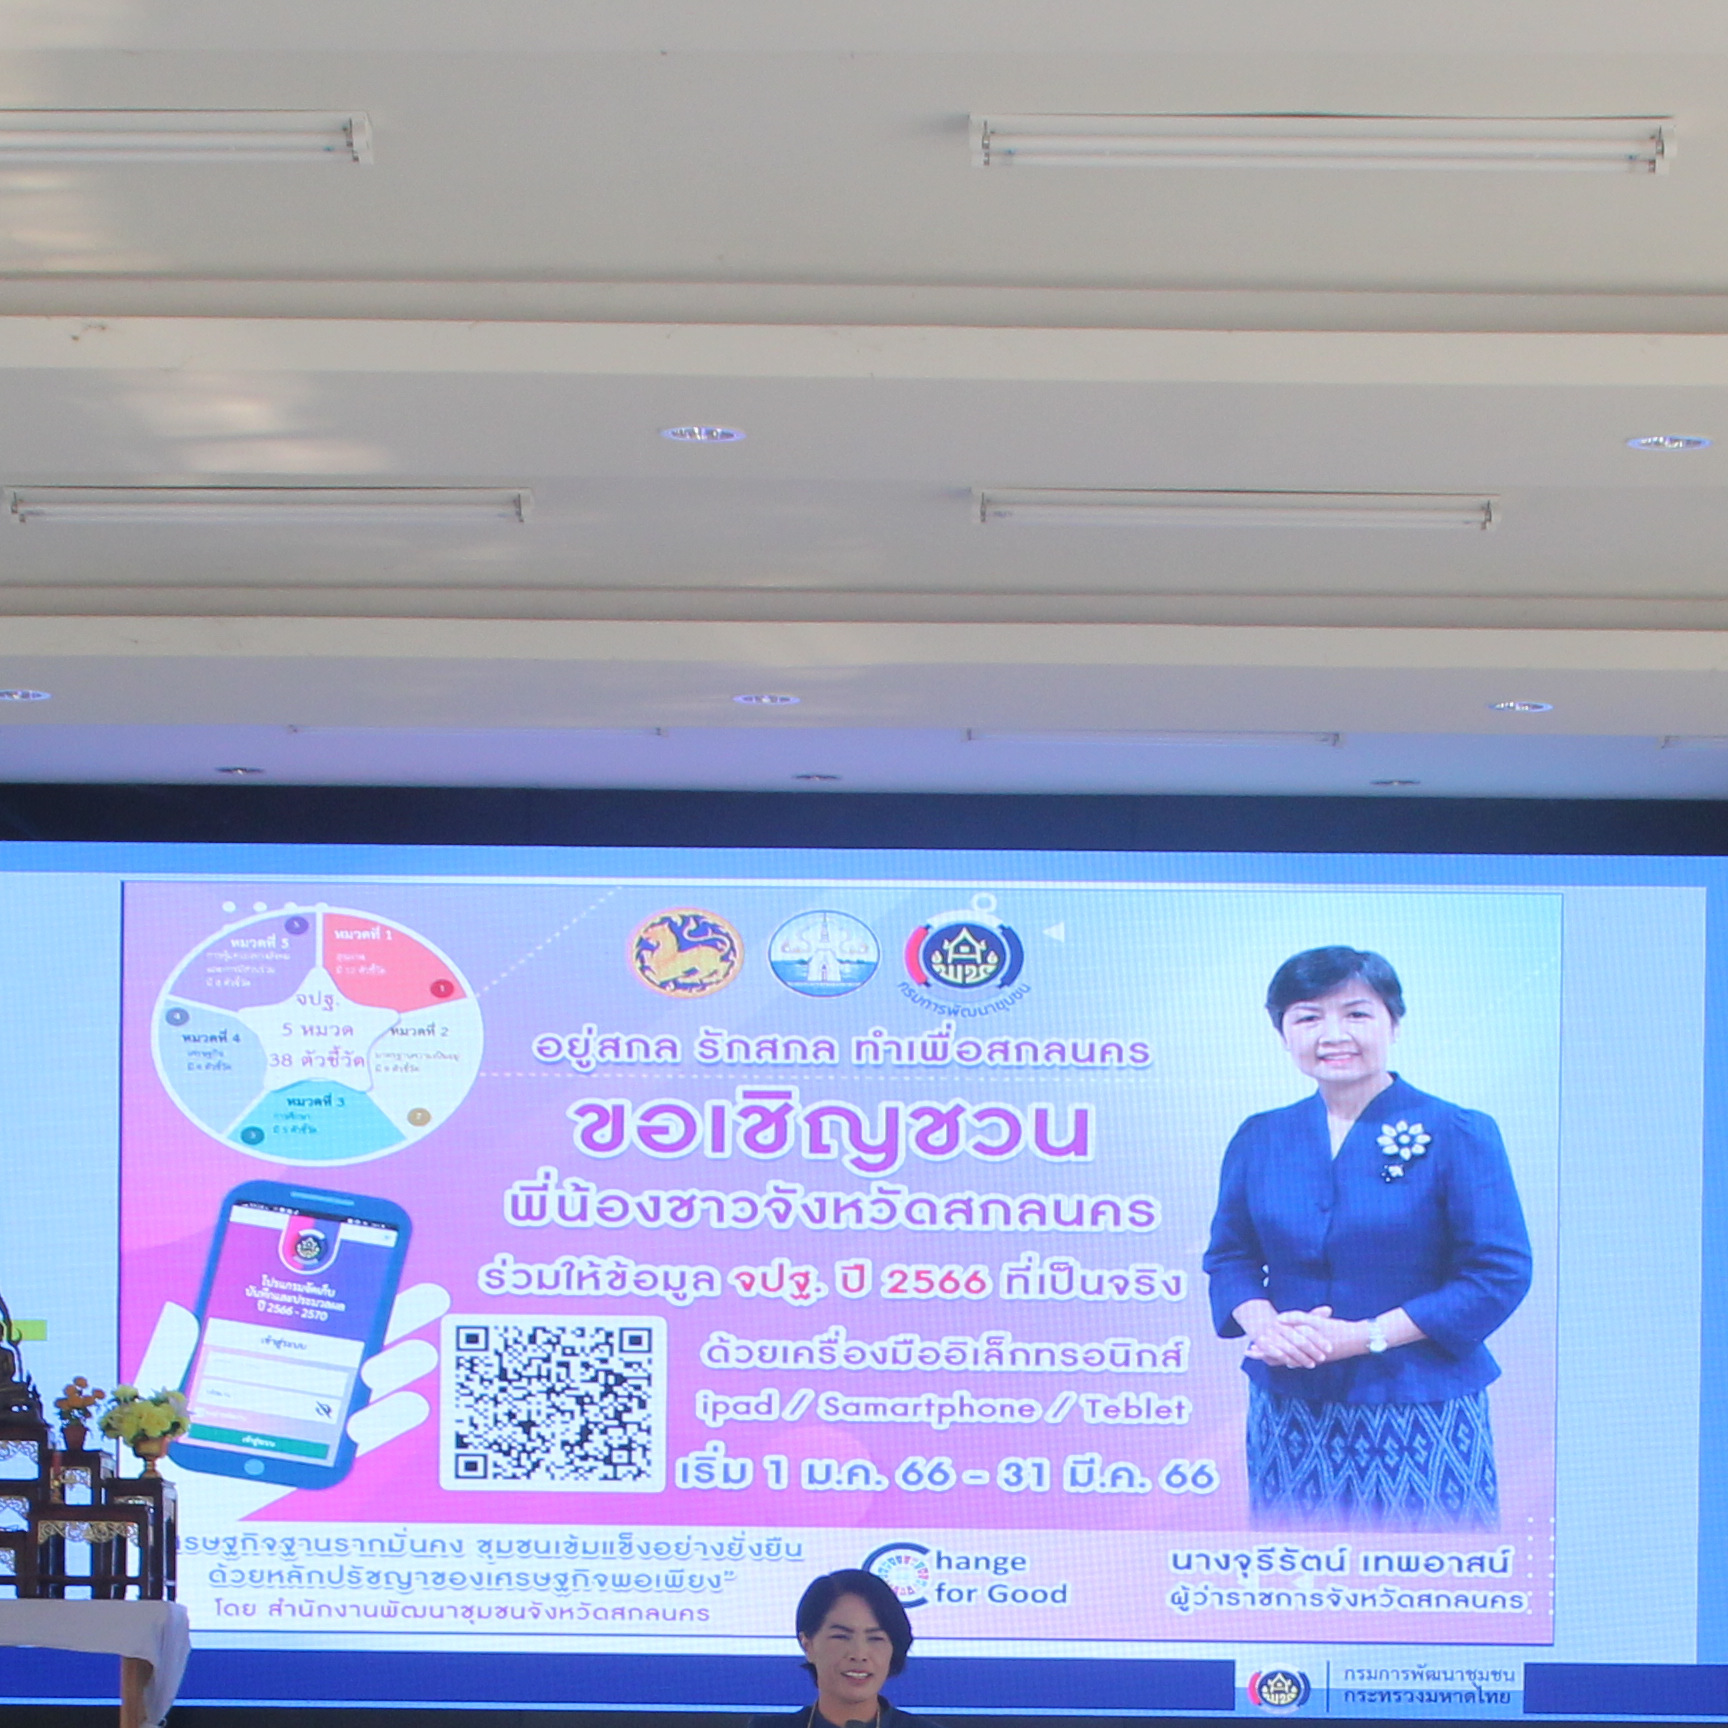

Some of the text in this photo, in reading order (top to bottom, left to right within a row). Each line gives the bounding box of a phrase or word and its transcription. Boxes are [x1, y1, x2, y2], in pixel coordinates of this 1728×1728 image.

[536, 1023, 1150, 1069] อยู่สกล รักสกล ทำเพื่อสกลนคร
[575, 1089, 1089, 1172] ขอเชิญชวน
[511, 1172, 1156, 1227] พี่น้องชาวจังหวัดสกลนคร
[485, 1256, 1182, 1302] ร่วมให้ข้อมูล จปฐ. ปี 2566 ที่เป็นจริง
[707, 1328, 1184, 1368] ด้วยเครื่องมืออิเล็กทรอนิกส์
[702, 1394, 772, 1422] ipad
[824, 1395, 1036, 1425] Samartphone
[1086, 1398, 1186, 1420] Teblet
[681, 1443, 747, 1485] เริ่ม
[768, 1462, 784, 1485] 1
[808, 1462, 883, 1486] ม.ค.
[901, 1461, 952, 1487] 66
[1004, 1462, 1045, 1487] 31
[1070, 1456, 1147, 1488] มี.ค.
[1165, 1463, 1215, 1489] 66
[176, 1528, 804, 1560] รษฐกิจฐานรากมั่นคง ชุมชนเข้มแข็งอย่างยั่งยืน
[1172, 1546, 1510, 1578] นางจุรีรัตน์ เทพอาสน์
[935, 1582, 1067, 1604] for Good
[1170, 1585, 1524, 1613] ผู้ว่าราชการจังหวัดสกลนคร
[215, 1598, 710, 1625] โดย สำนักงานพัฒนาชุมชนจังหวัดสกลนคร
[1344, 1663, 1515, 1689] กรมการพัฒนาชุมชน
[1344, 1684, 1511, 1704] กระทรวงมหาดไทย
